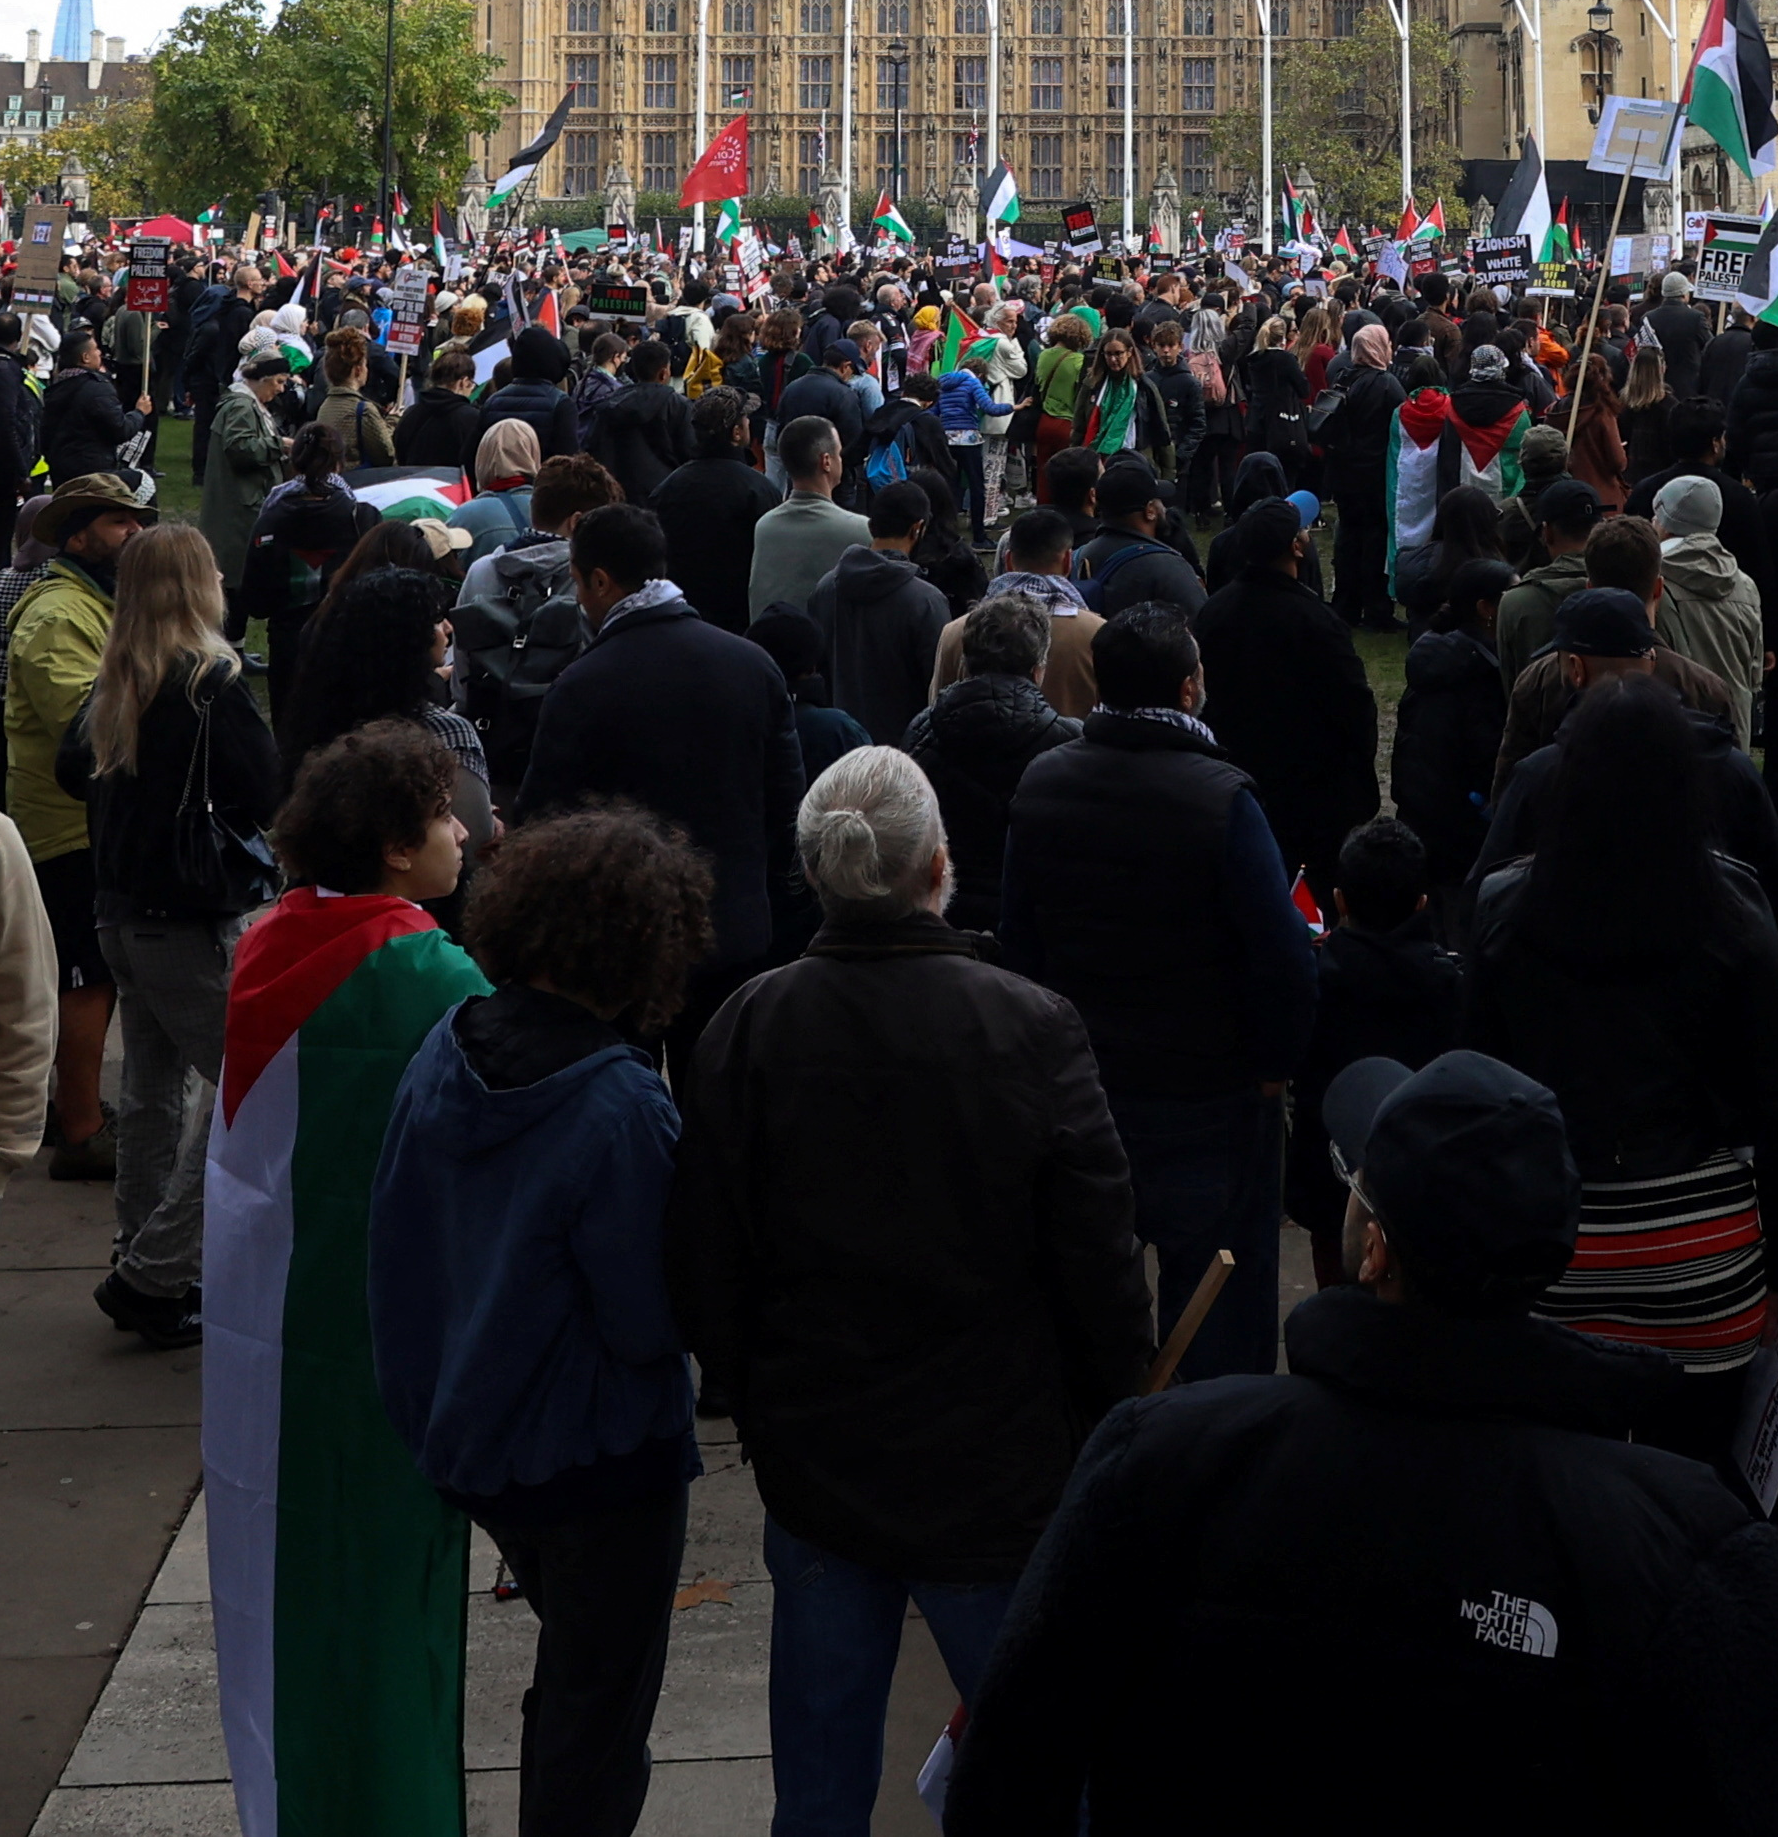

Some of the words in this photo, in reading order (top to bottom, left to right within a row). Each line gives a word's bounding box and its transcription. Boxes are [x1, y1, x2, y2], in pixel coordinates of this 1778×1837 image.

[132, 246, 166, 259] FREEDOM
[947, 242, 965, 255] Free
[1475, 240, 1528, 259] ZIONISM
[130, 264, 167, 277] PALESTINE
[1485, 260, 1523, 275] WHITE
[1475, 274, 1529, 290] SUPREMAC
[1532, 278, 1568, 288] AL-AQSA
[1698, 270, 1743, 285] PALESTI
[591, 297, 645, 312] PALESTINE
[1491, 1590, 1528, 1616] THE
[1460, 1599, 1527, 1635] NORTH
[1475, 1625, 1522, 1652] FACE
